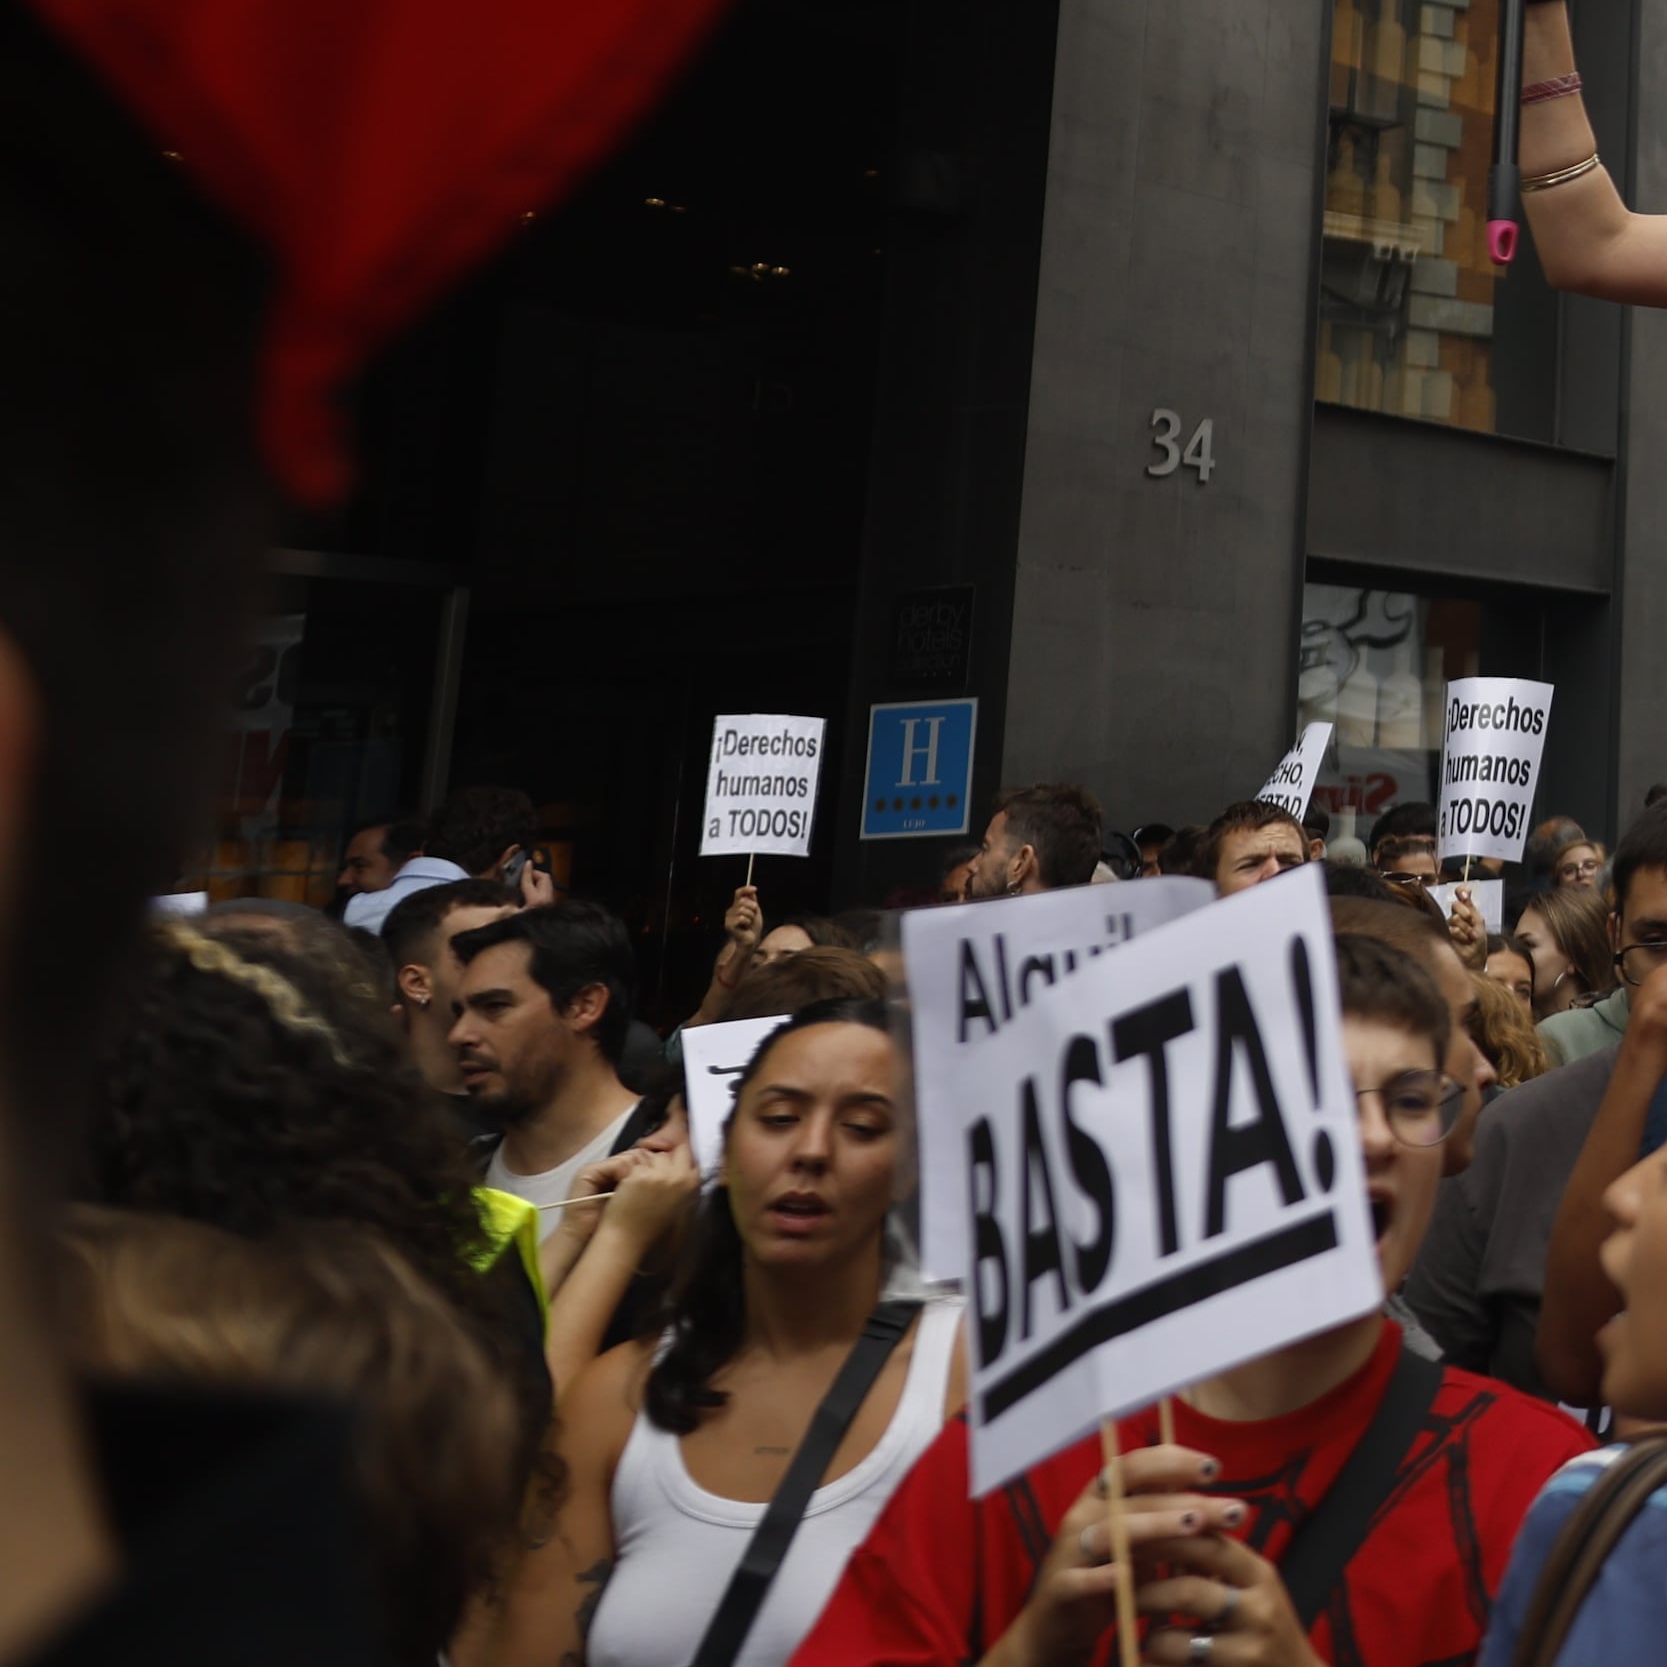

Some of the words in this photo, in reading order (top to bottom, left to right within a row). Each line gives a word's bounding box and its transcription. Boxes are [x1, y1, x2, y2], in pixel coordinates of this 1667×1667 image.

[1147, 408, 1216, 482] 34
[715, 729, 818, 764] ¡Derechos
[895, 716, 946, 787] H
[715, 769, 809, 798] humanos
[1445, 749, 1532, 787] humanos
[708, 816, 720, 839] a
[728, 809, 809, 840] TODOS!
[1449, 798, 1527, 841] TODOS!
[967, 932, 1337, 1372] BASTA!
